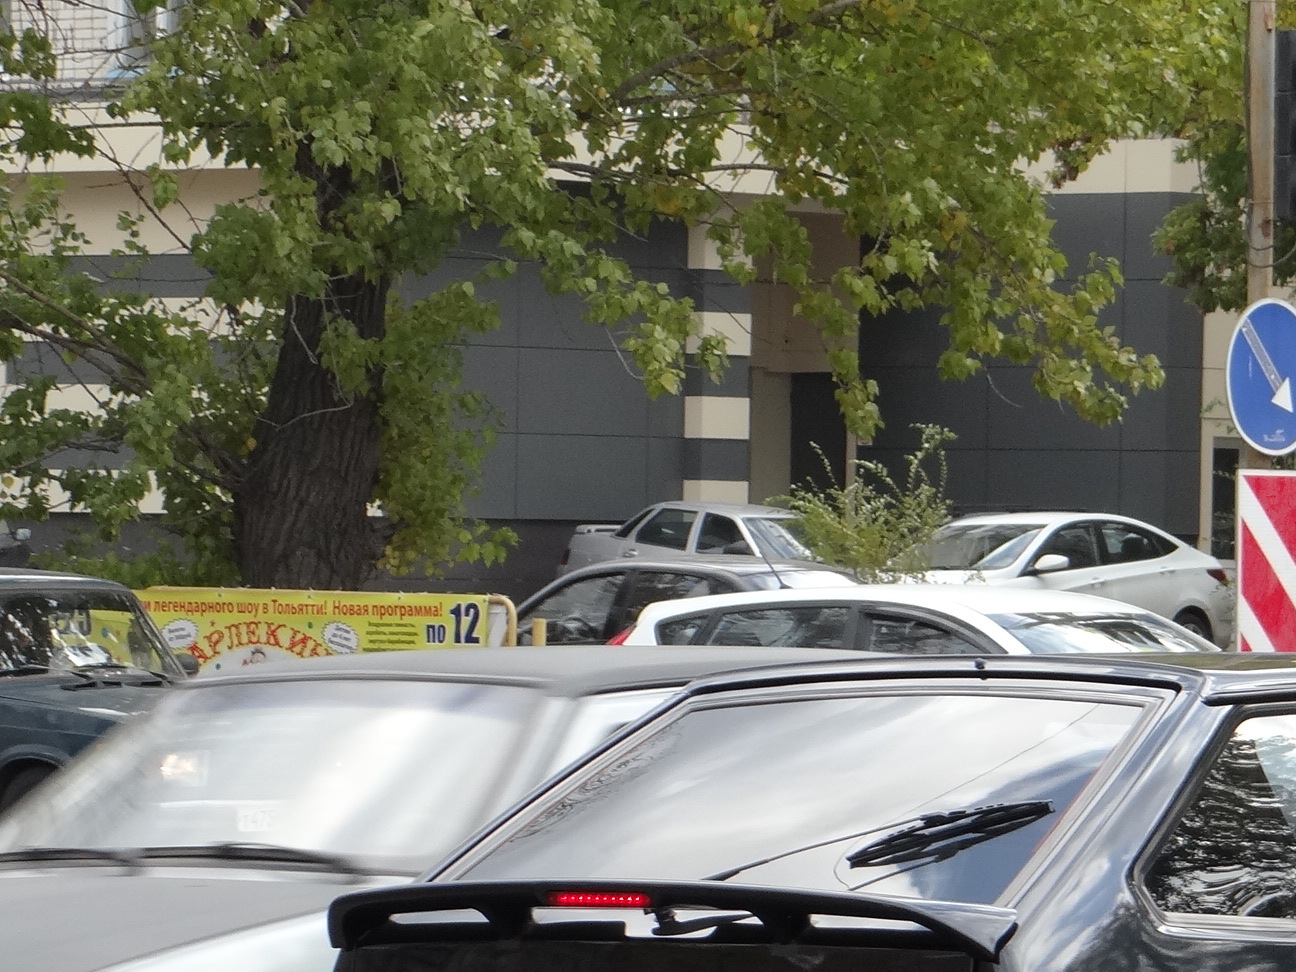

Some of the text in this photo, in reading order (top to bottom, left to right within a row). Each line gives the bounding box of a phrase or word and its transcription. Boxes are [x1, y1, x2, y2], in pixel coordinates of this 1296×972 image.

[153, 600, 234, 617] легендарного
[237, 603, 258, 618] шоу
[263, 605, 269, 613] в
[271, 600, 327, 616] Тольятти!
[332, 600, 369, 616] Новая
[372, 601, 443, 621] программа!
[426, 602, 480, 645] по 12
